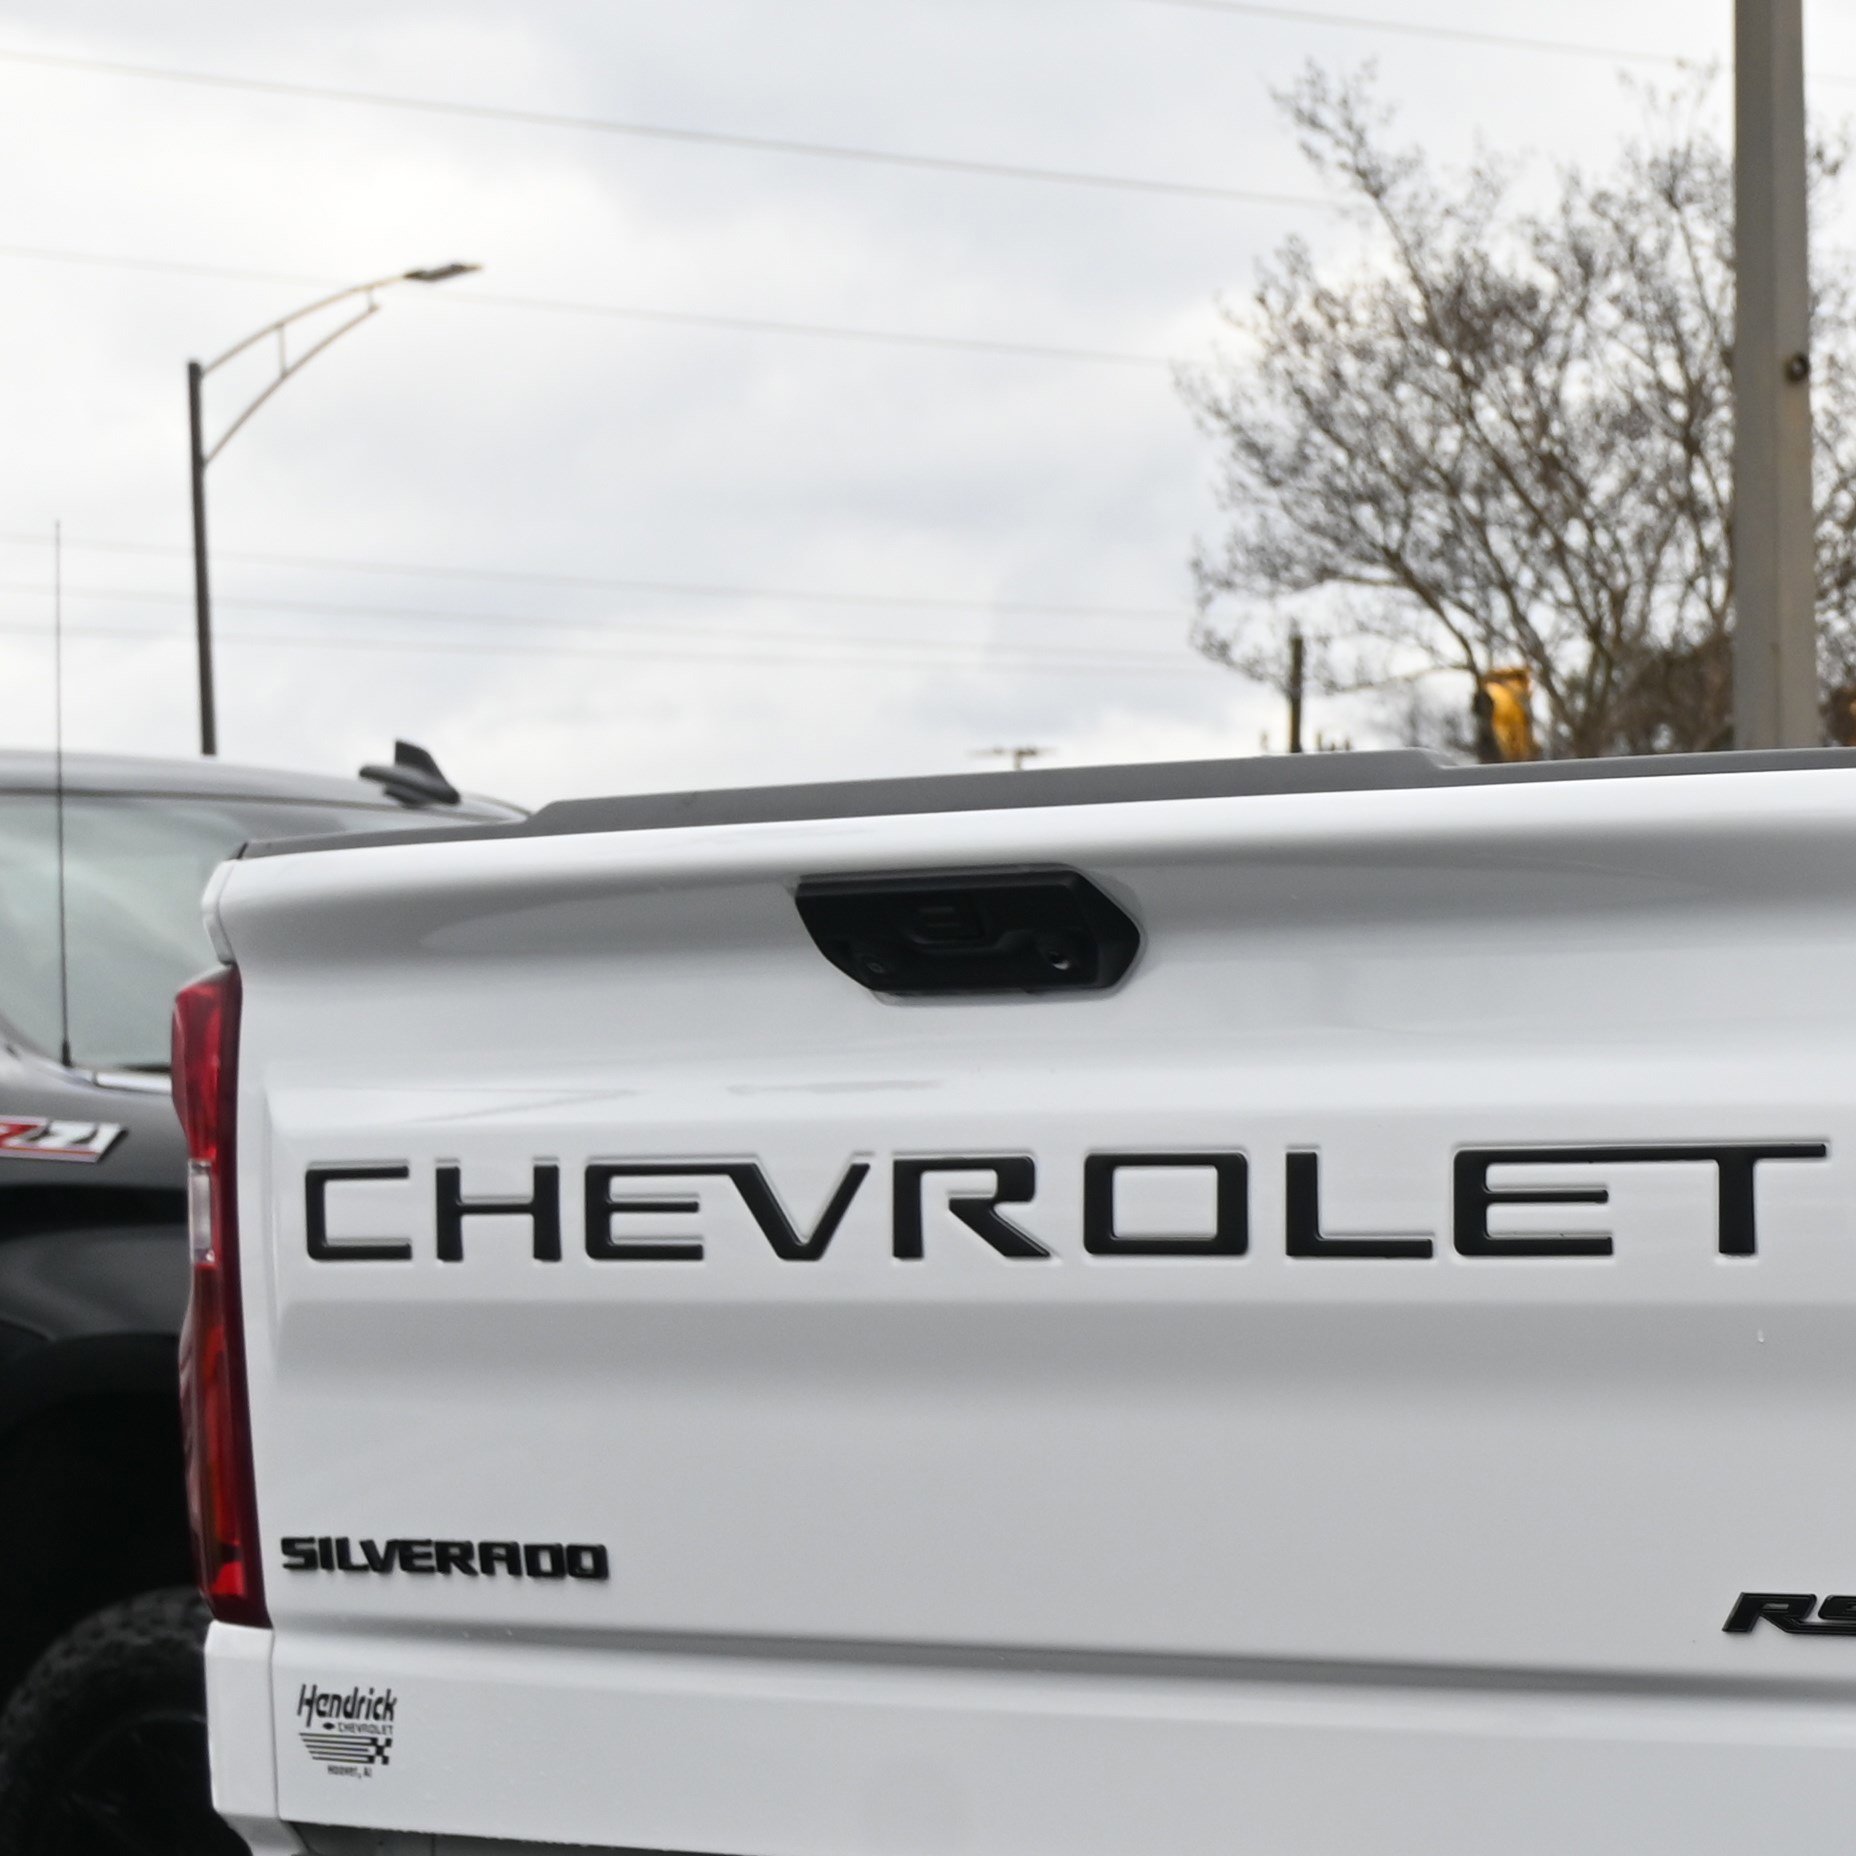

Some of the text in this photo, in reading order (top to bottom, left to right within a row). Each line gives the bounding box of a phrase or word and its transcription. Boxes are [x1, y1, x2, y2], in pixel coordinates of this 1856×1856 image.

[304, 1142, 1828, 1262] CHEVROLET
[280, 1536, 609, 1580] SILVERADO
[297, 1684, 397, 1728] Hendrick
